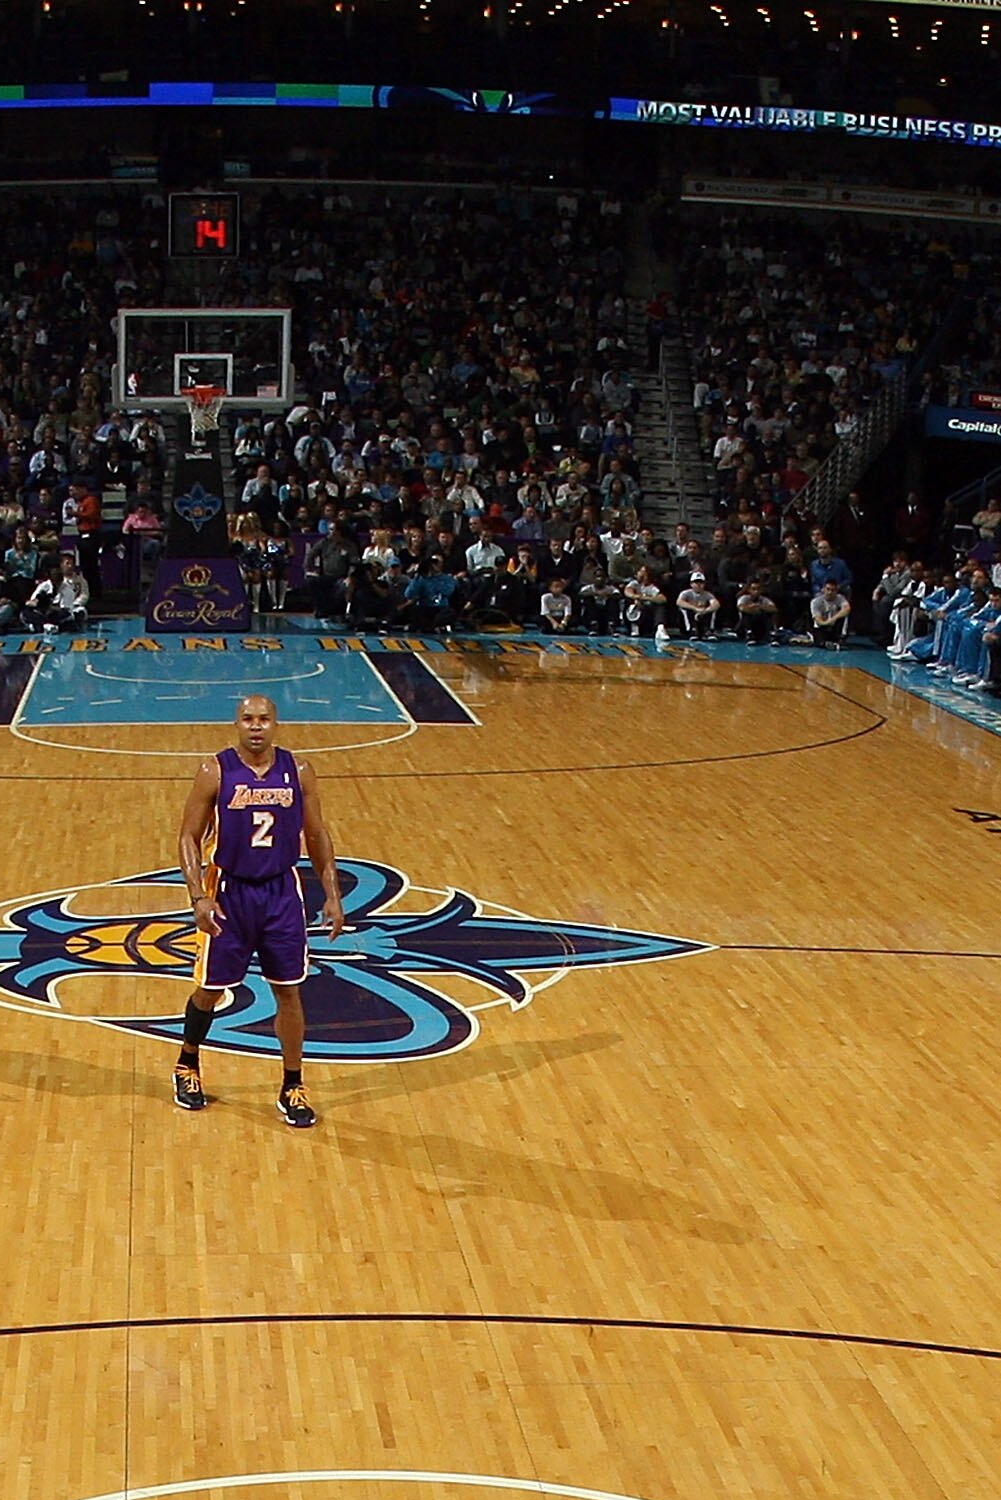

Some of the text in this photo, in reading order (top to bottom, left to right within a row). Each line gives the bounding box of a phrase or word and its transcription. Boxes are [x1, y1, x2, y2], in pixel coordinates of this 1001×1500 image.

[636, 100, 707, 121] MOST
[710, 104, 837, 131] VALUABLE
[843, 112, 967, 140] BUSINESS
[195, 218, 227, 249] 14
[152, 600, 244, 626] Crown Royal
[227, 784, 294, 810] LAKERS
[251, 811, 275, 848] 2
